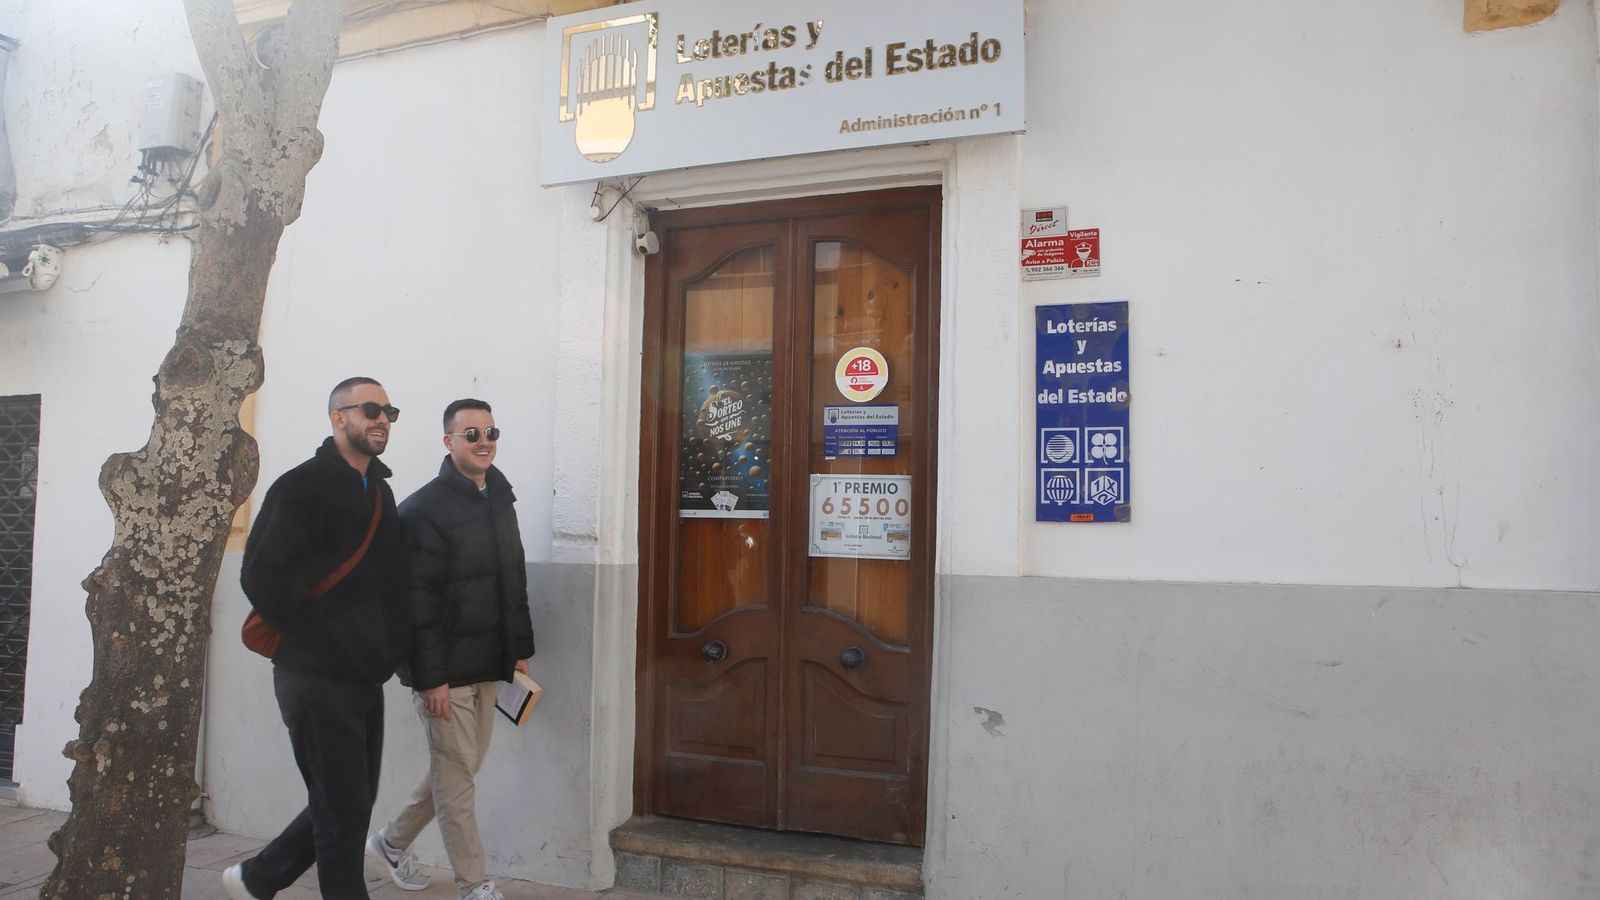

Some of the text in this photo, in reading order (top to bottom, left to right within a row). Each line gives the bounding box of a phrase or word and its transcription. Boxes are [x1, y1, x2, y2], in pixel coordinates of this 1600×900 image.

[676, 19, 824, 64] Loterías y
[675, 31, 1002, 108] Apuestas del Estado
[839, 106, 966, 134] Administración
[993, 101, 1003, 117] 1
[1070, 231, 1098, 239] Vigilante
[1025, 239, 1065, 249] Alarma
[1047, 318, 1117, 334] Loterías
[1077, 339, 1087, 354] y
[851, 359, 871, 372] +18
[1043, 359, 1122, 377] Apuestas
[722, 397, 732, 406] EL
[1038, 388, 1128, 404] del Estado
[708, 400, 743, 421] SORTEO
[710, 417, 742, 437] NOS UNE
[844, 482, 899, 495] PREMIO
[821, 497, 909, 516] 65500
